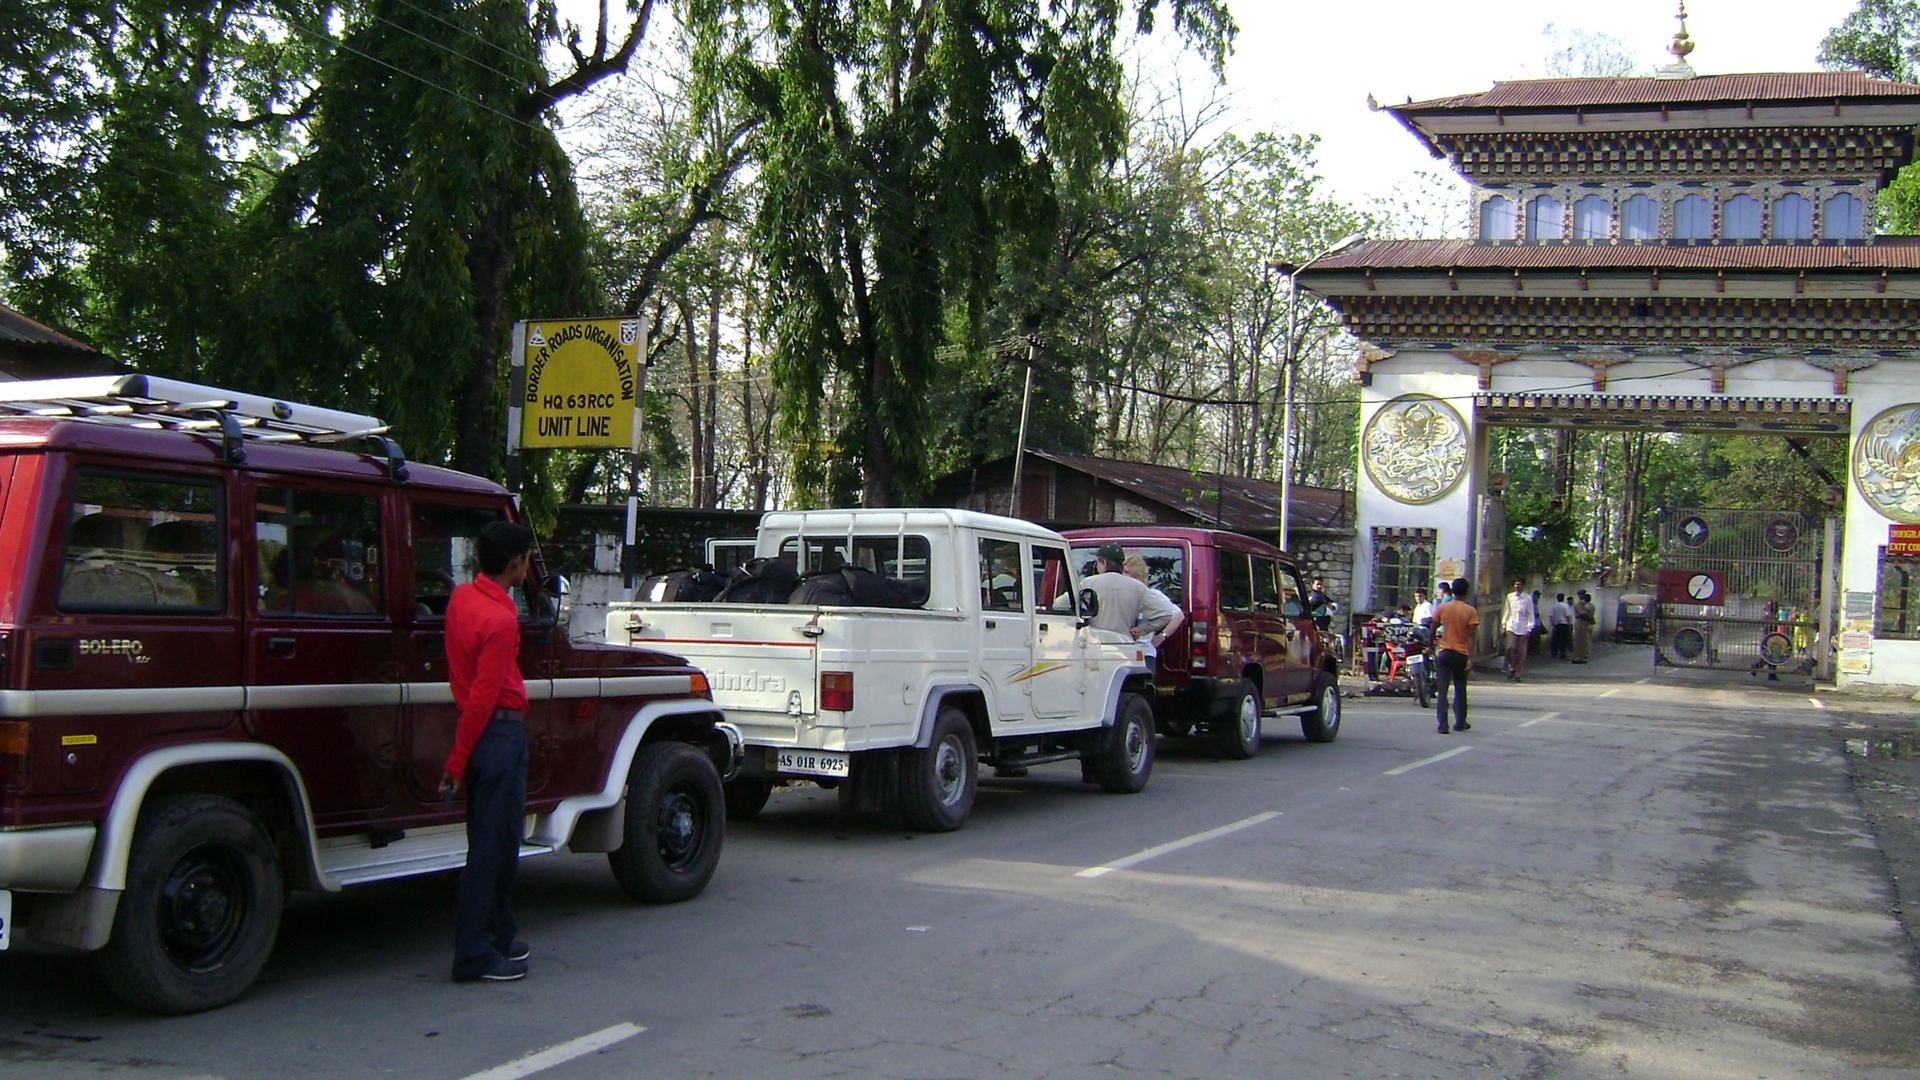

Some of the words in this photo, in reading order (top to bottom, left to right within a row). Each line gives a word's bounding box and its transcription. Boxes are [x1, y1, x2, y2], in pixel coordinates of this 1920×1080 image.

[526, 347, 550, 403] BORDER
[548, 324, 582, 352] ROADS
[584, 324, 634, 401] ORGANISATION
[543, 395, 563, 409] HQ
[538, 417, 573, 437] UNIT
[577, 416, 611, 437] LINE
[1889, 543, 1907, 551] EXIT
[79, 639, 143, 656] BOLERO
[779, 754, 793, 767] AS
[797, 756, 815, 769] 01R
[820, 757, 844, 771] 6925
